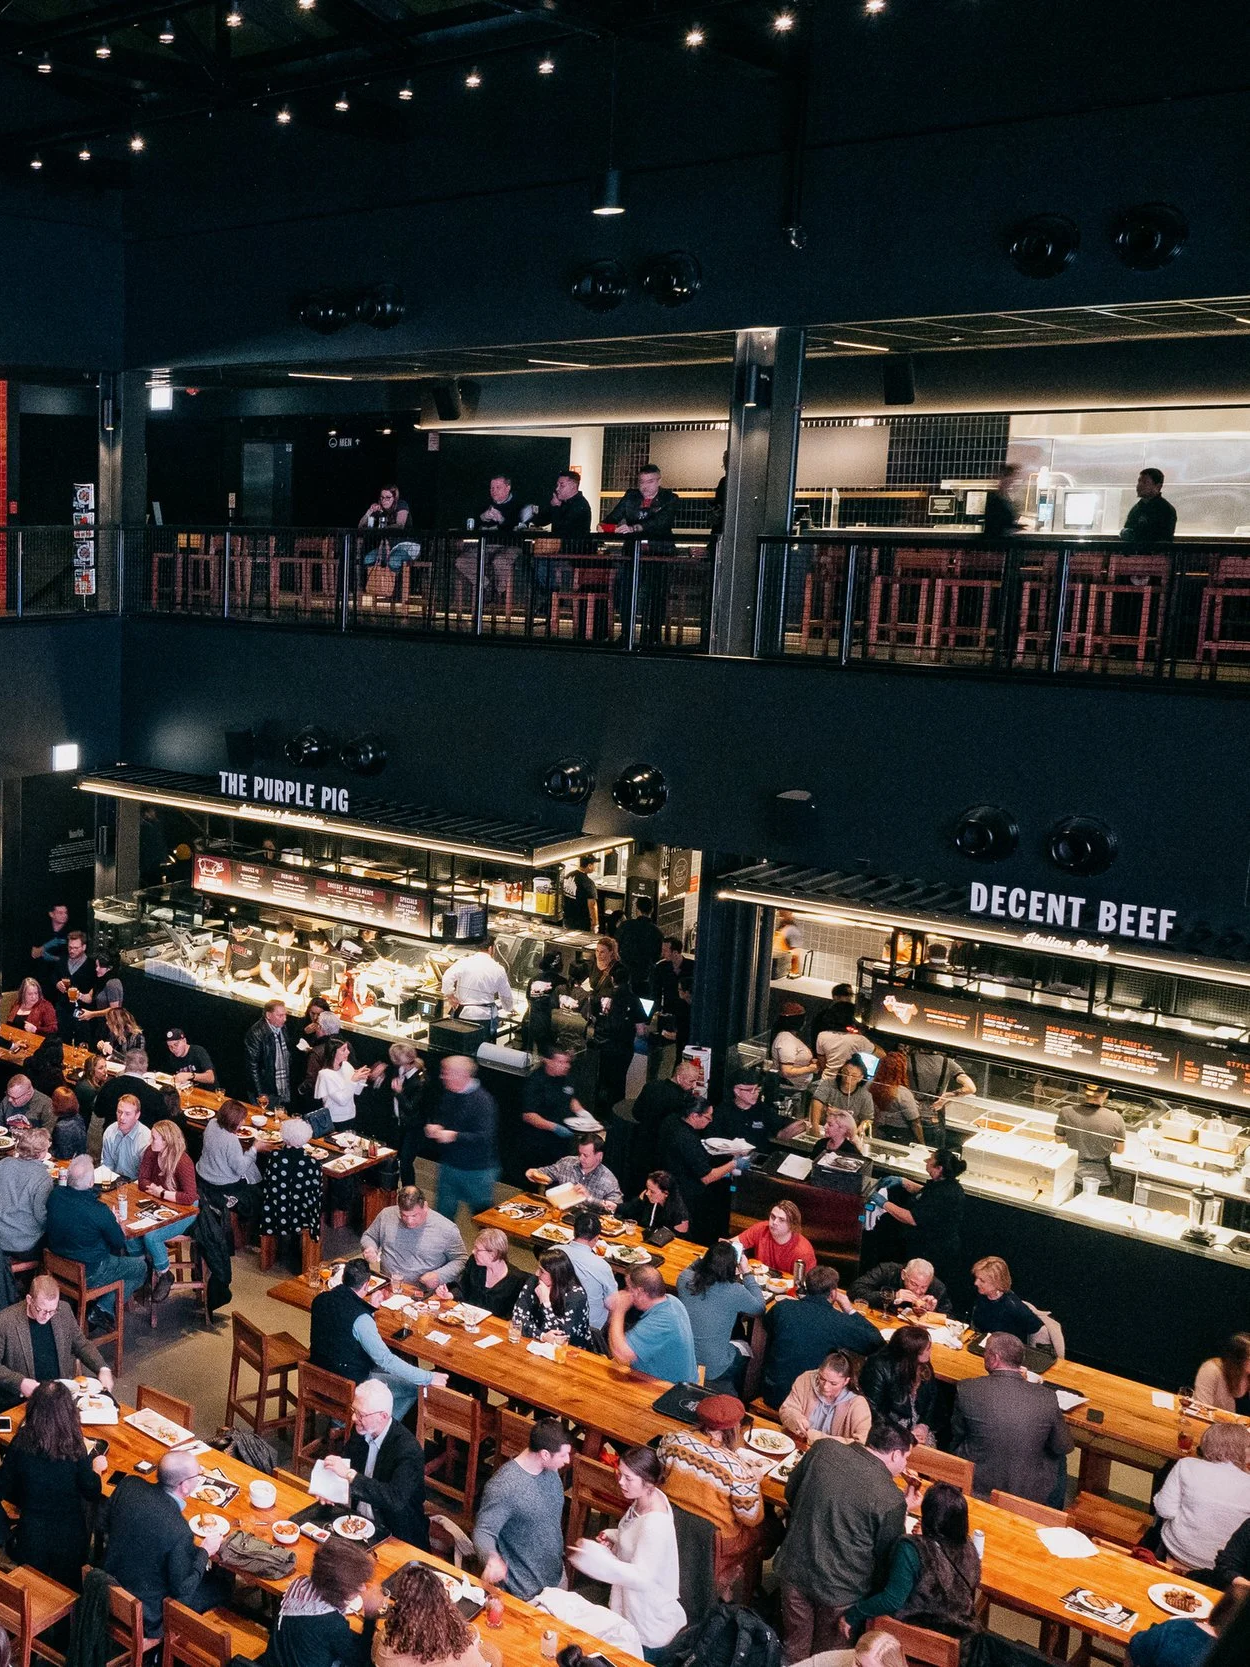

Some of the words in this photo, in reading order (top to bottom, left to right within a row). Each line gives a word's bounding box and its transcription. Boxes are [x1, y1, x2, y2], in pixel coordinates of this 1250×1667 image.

[339, 437, 353, 447] MEN
[218, 770, 248, 797] THE
[253, 775, 315, 808] PURPLE
[321, 785, 349, 813] PIG
[969, 881, 1086, 928] DECENT
[1097, 900, 1177, 941] BEEF
[1022, 931, 1072, 950] Italian
[1073, 939, 1110, 959] Beef
